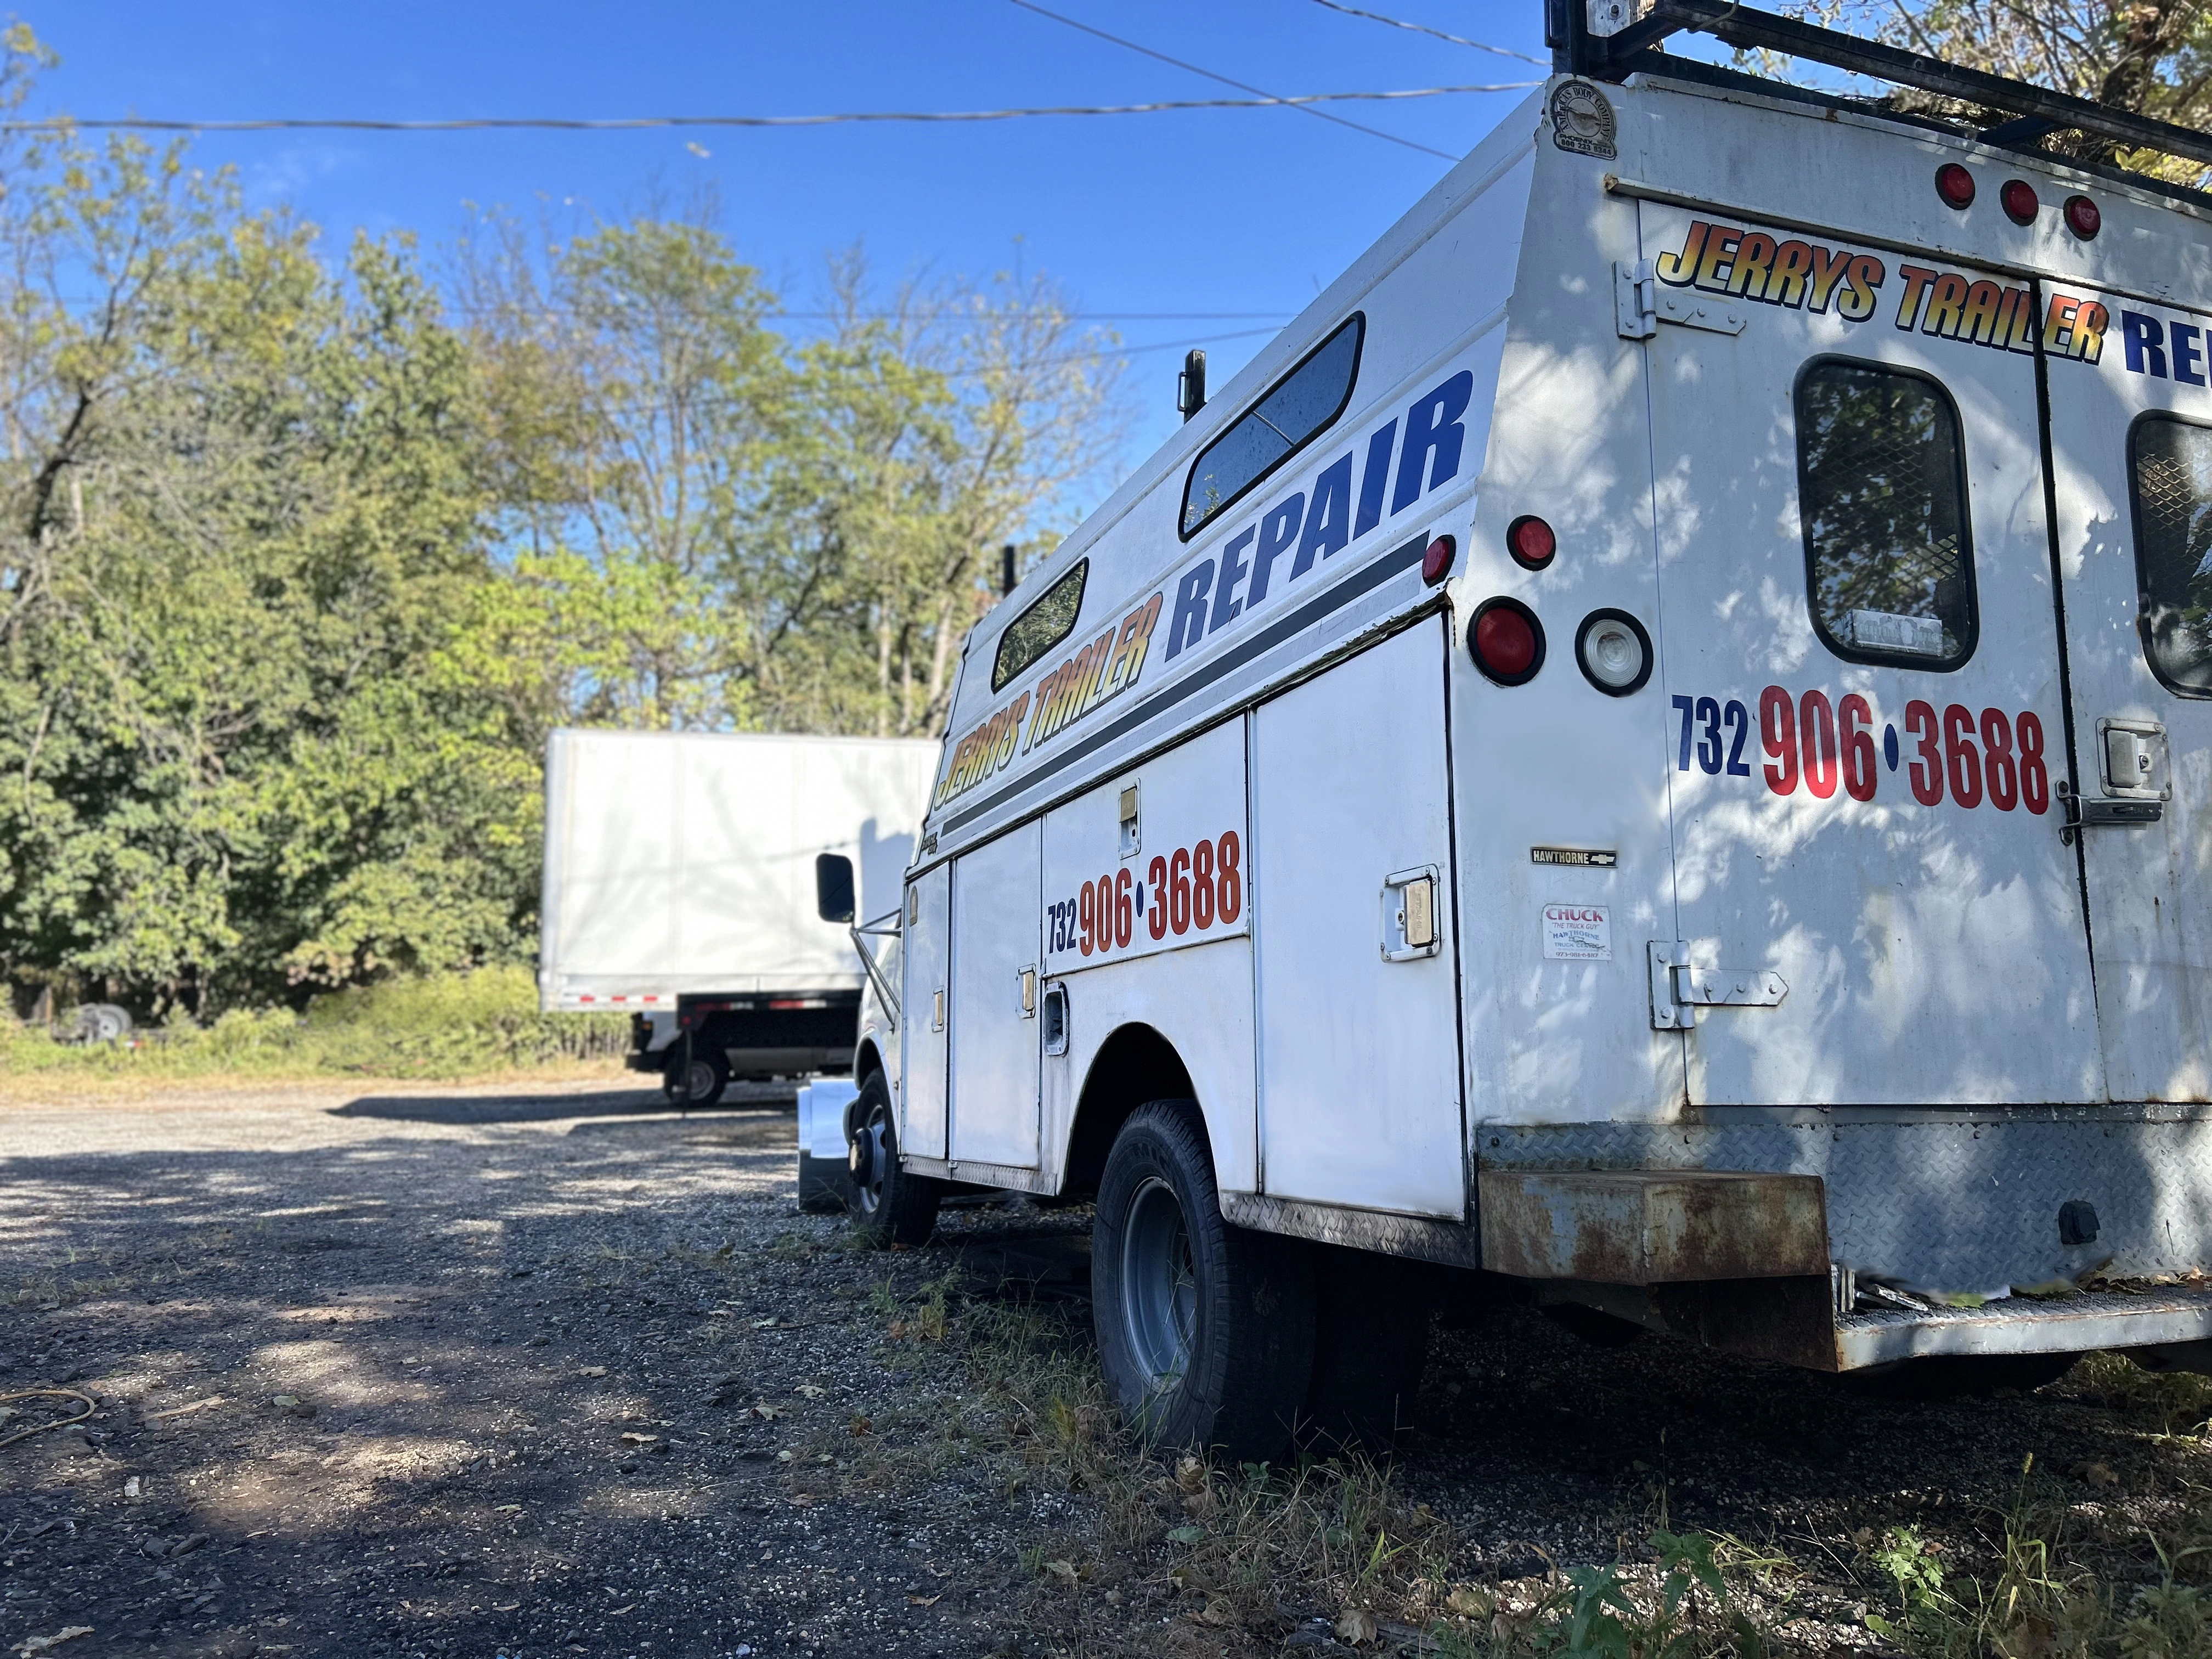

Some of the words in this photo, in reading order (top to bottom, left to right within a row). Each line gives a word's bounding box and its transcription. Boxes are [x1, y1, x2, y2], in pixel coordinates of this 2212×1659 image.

[1572, 87, 1594, 100] BODY
[1595, 98, 1611, 138] COMPANY
[1560, 134, 1593, 145] PHOENIX
[1561, 139, 1575, 148] 800
[1656, 220, 1886, 323] JERRYS
[1895, 264, 2110, 365] TRAILER
[2121, 310, 2212, 388] RE
[934, 690, 1030, 811] JERRYS
[1022, 591, 1164, 757] TRAILER
[1165, 370, 1474, 663] REPAIR
[1672, 695, 1751, 777] 732
[1533, 850, 1589, 864] HAWTHORNE
[1048, 898, 1076, 954] 732
[1546, 908, 1604, 922] CHUCK
[1553, 930, 1600, 940] HAWTHORNE
